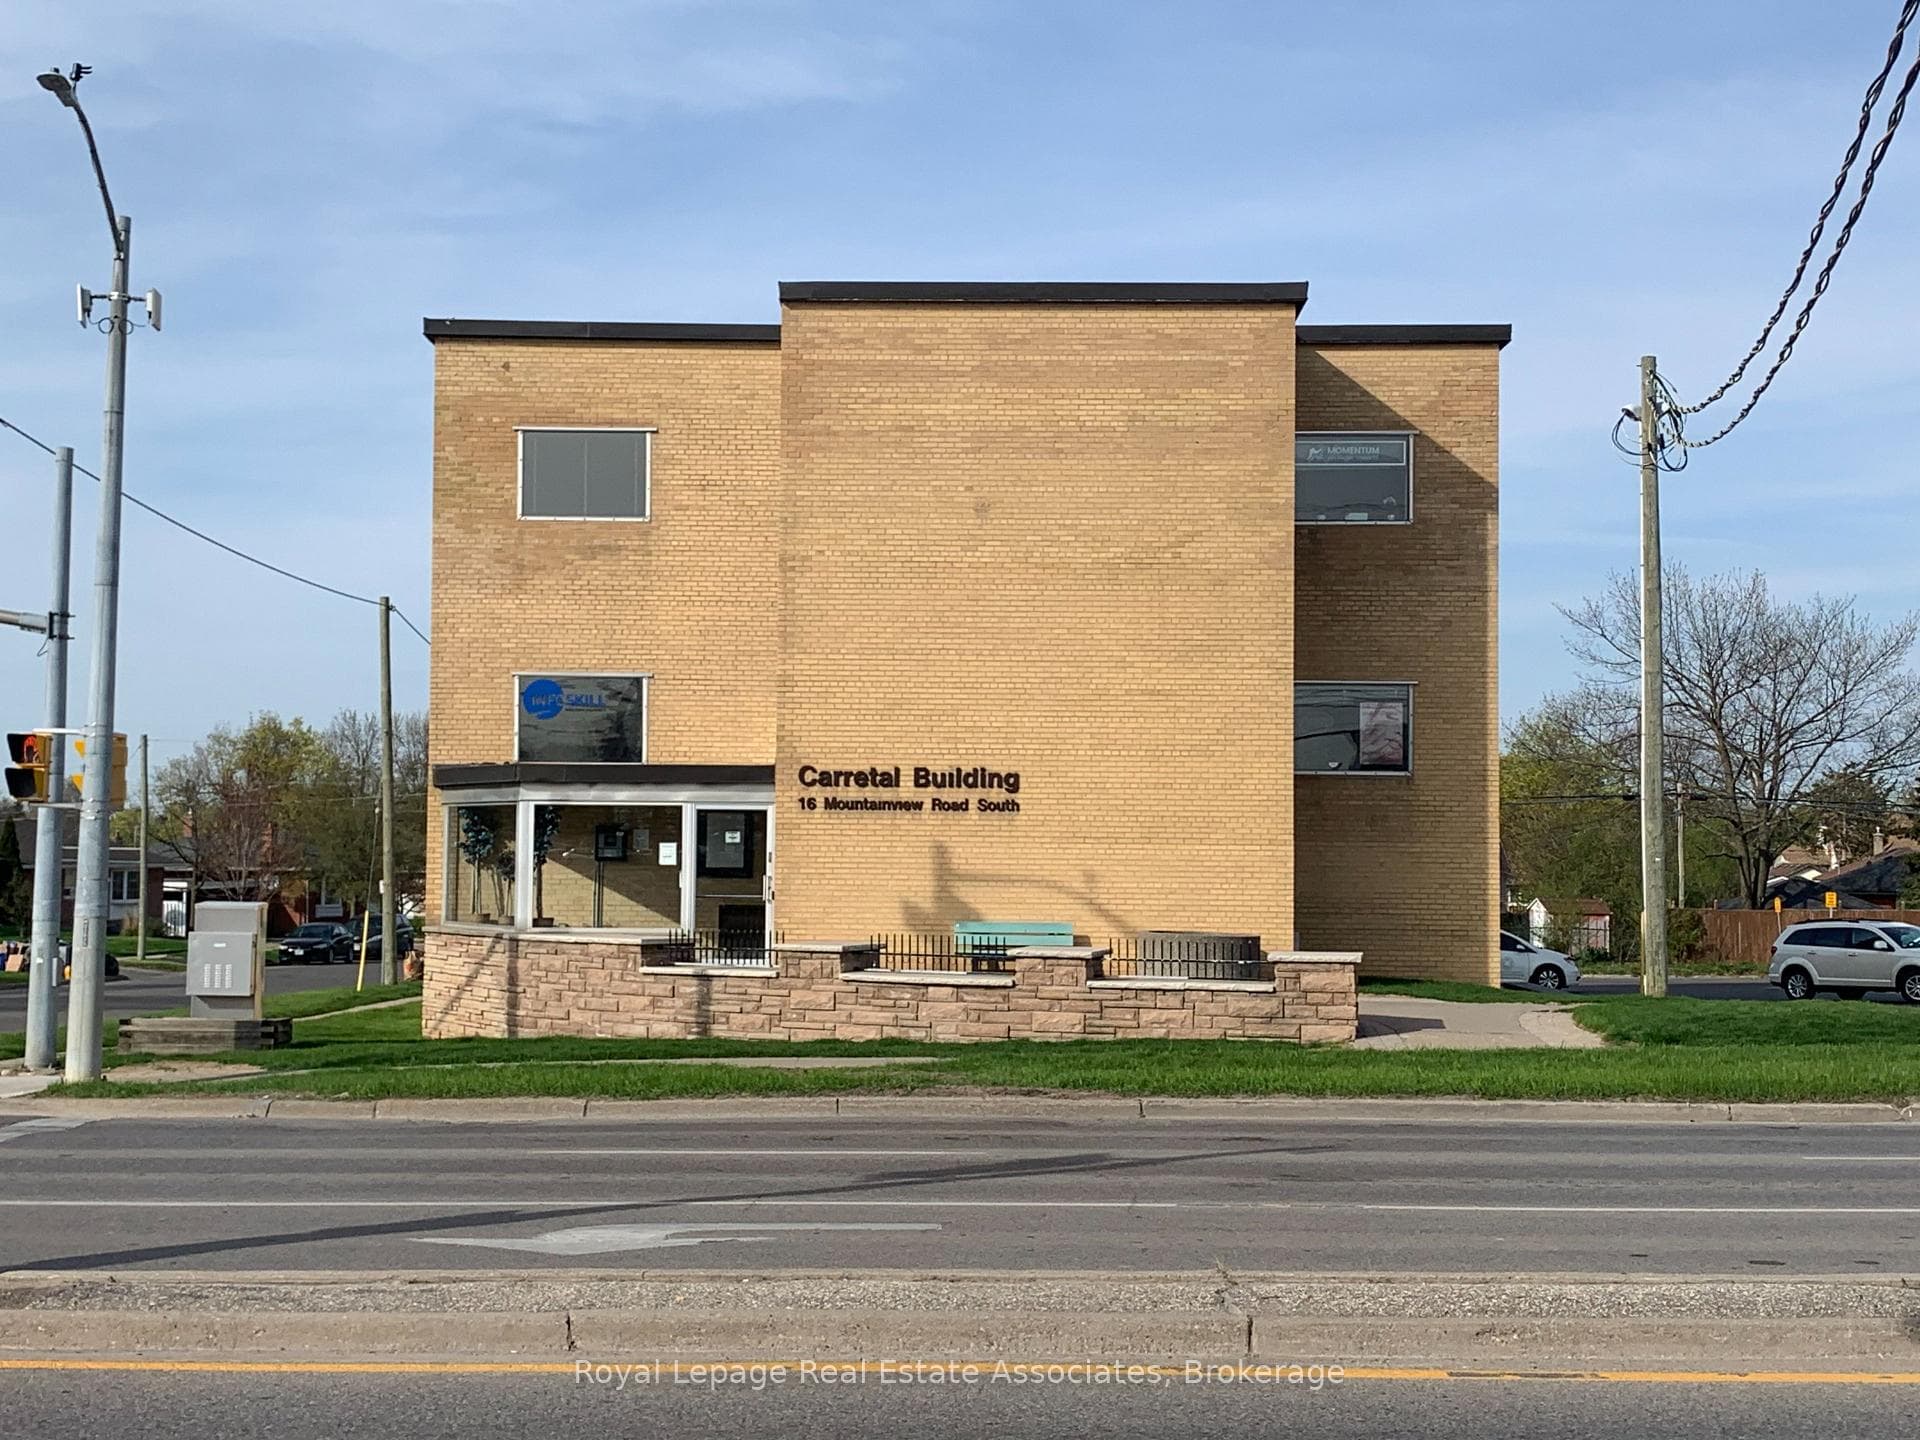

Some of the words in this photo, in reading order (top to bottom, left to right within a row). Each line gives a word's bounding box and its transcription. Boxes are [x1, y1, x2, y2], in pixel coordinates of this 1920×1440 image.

[1327, 446, 1380, 454] MOMENTUM
[798, 765, 901, 788] Carretal
[914, 767, 1020, 793] Building
[798, 797, 817, 810] 16
[824, 797, 924, 811] Mountainview
[931, 798, 969, 811] Road
[977, 798, 1020, 812] South
